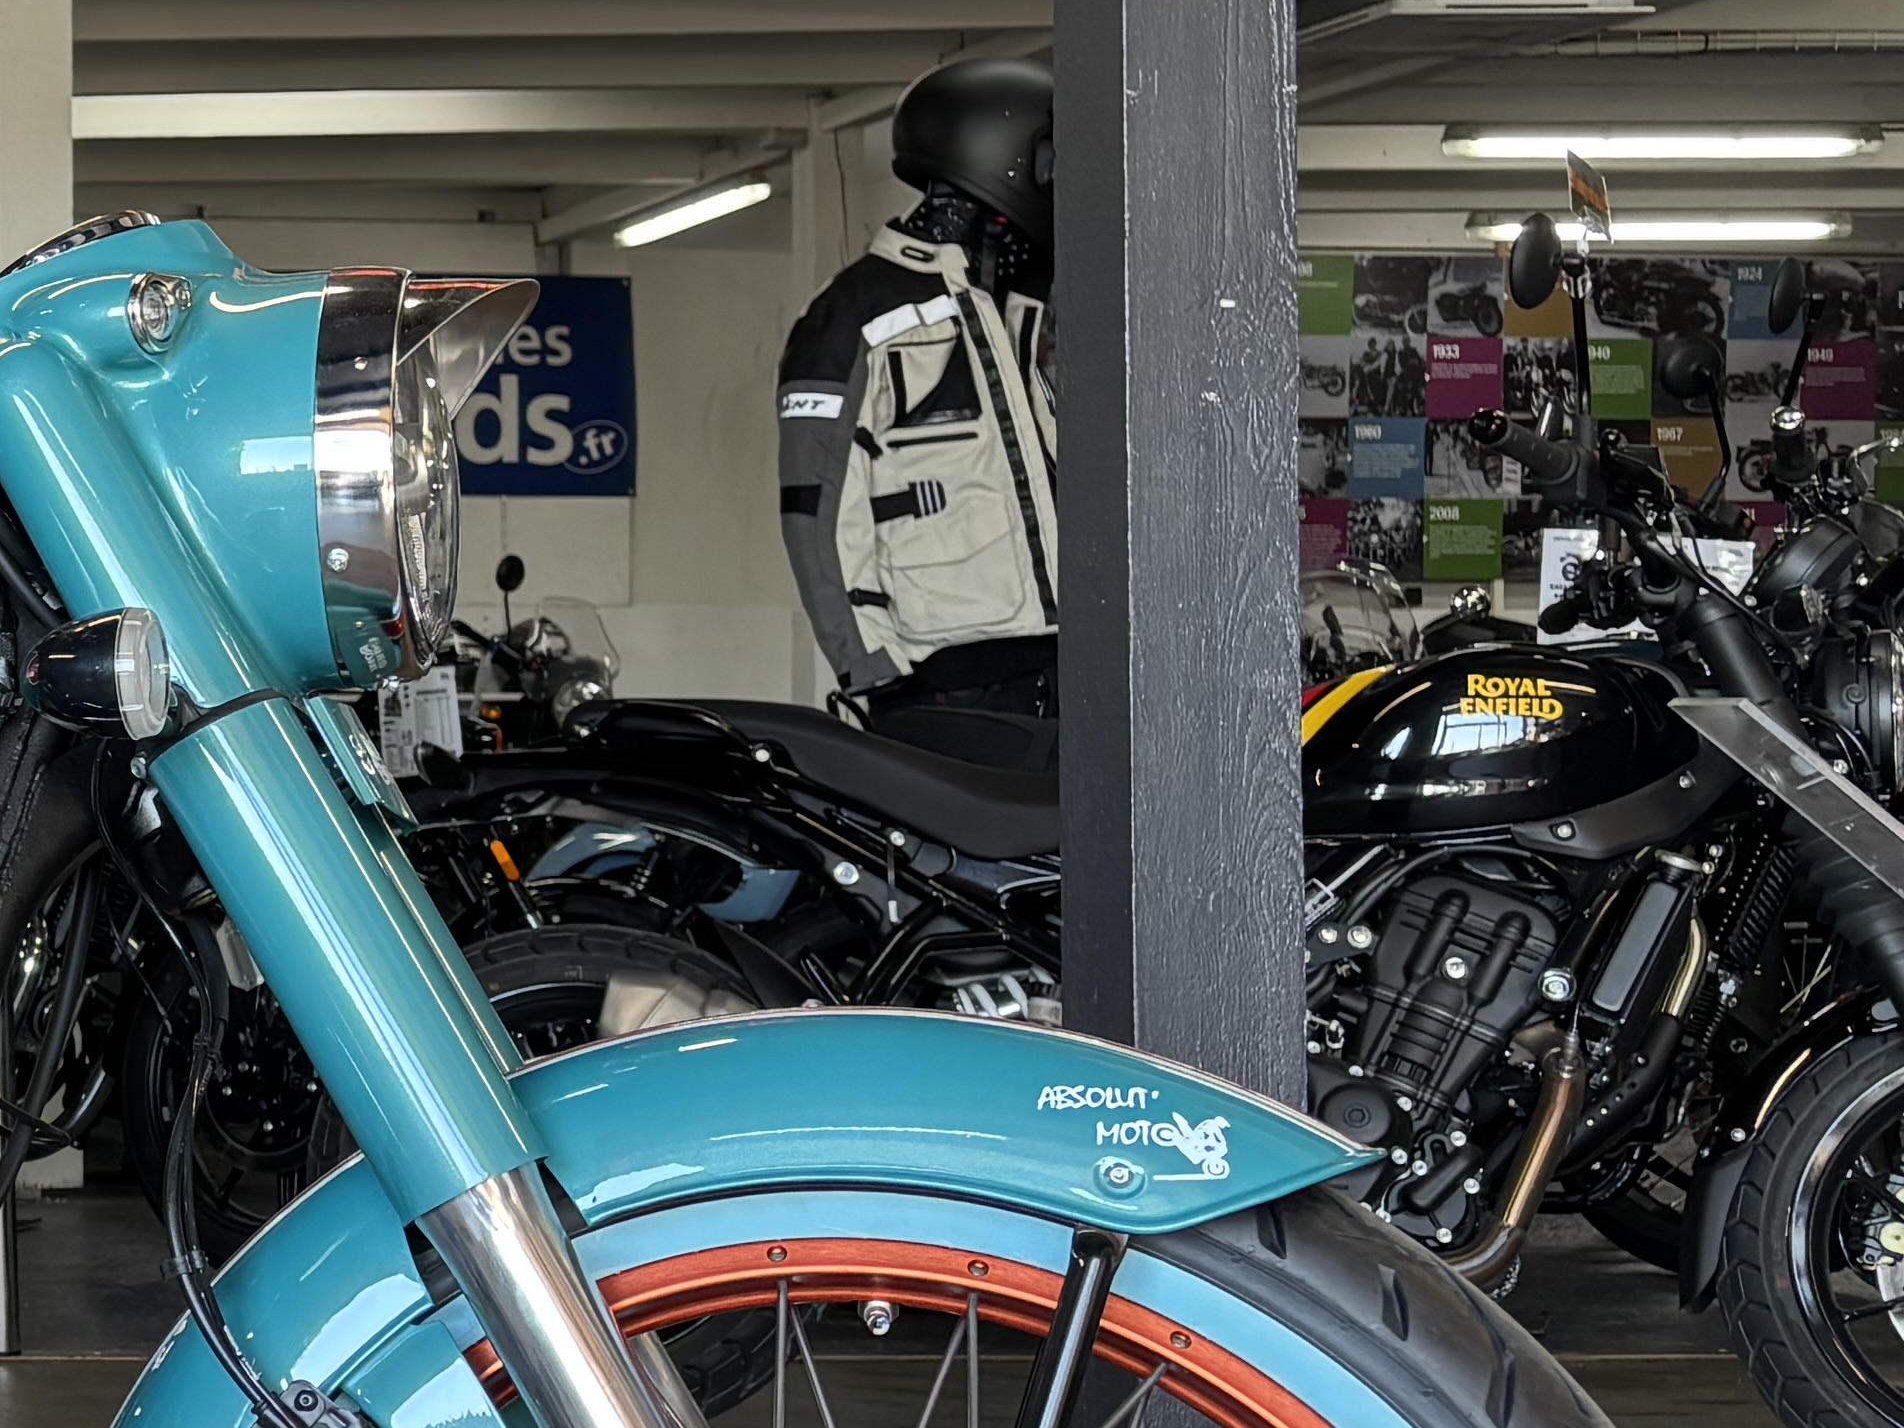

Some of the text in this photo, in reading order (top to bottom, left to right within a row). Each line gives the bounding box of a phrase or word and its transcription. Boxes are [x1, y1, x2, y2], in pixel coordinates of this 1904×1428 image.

[495, 324, 573, 367] es
[1587, 346, 1610, 361] 940
[1467, 674, 1552, 698] ROYAL
[1459, 697, 1564, 721] ENFIELD
